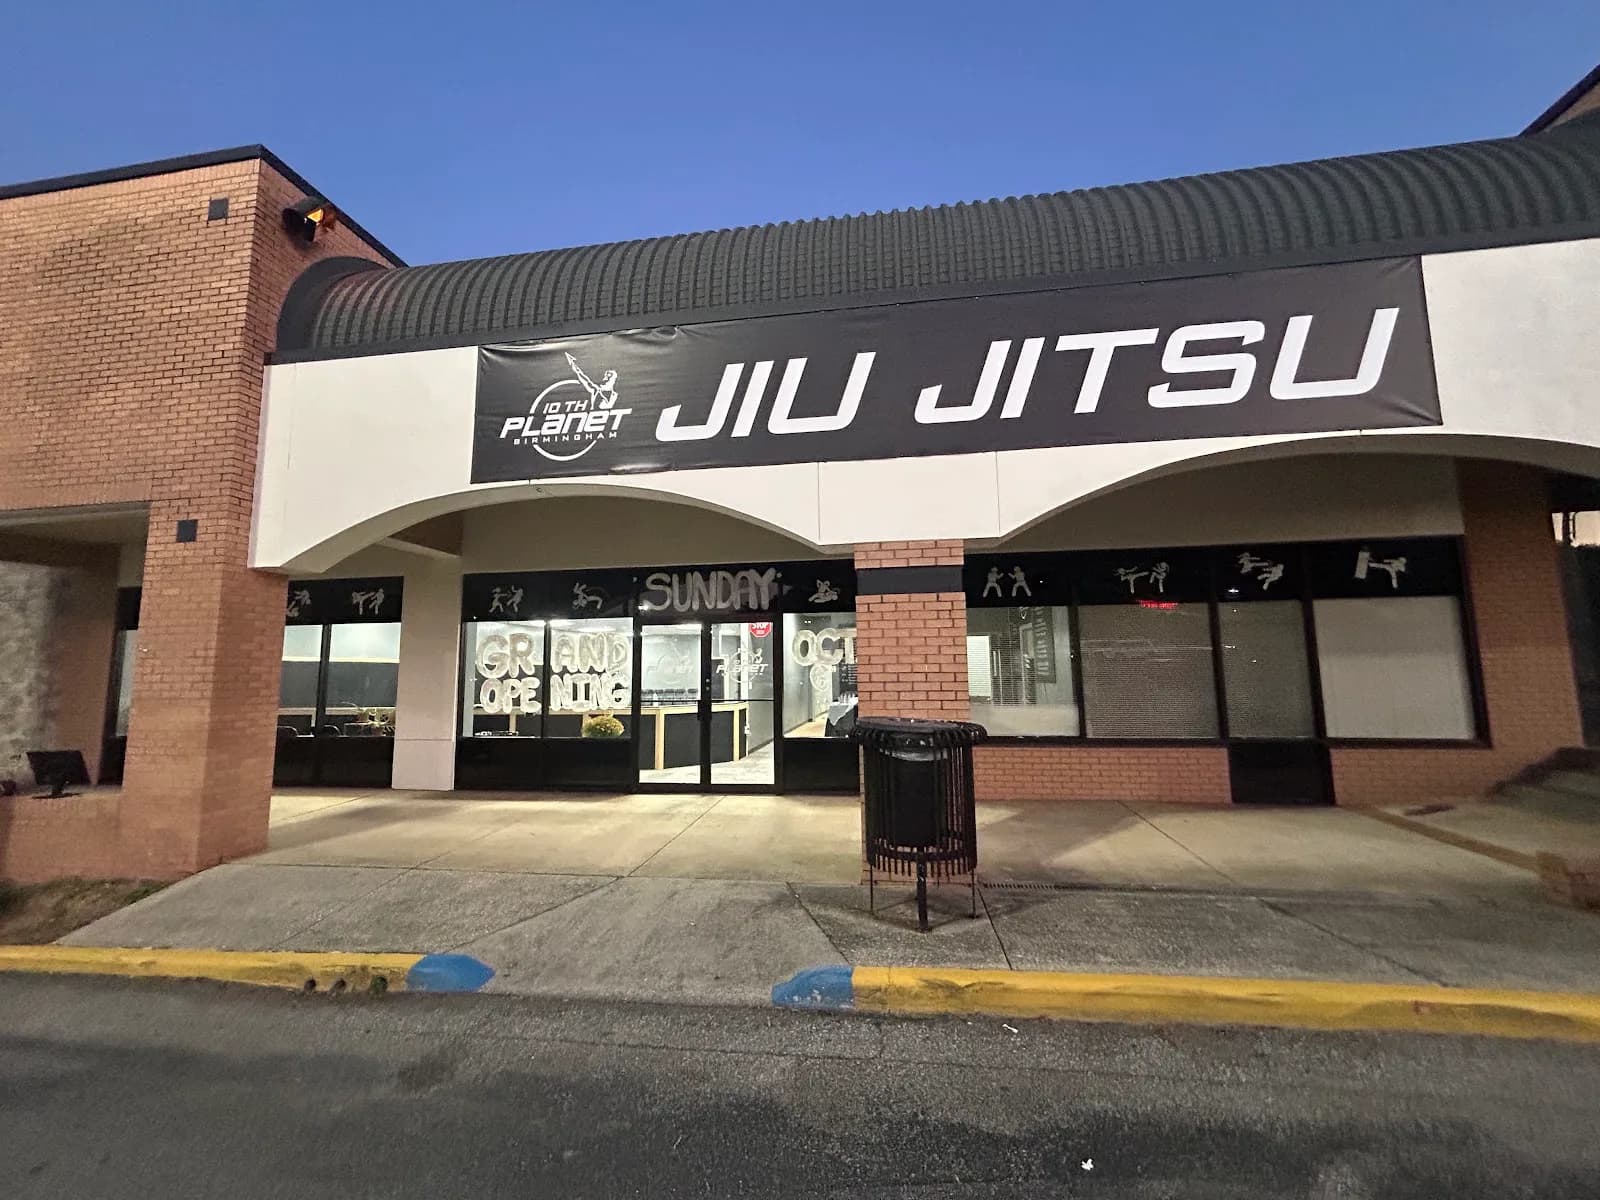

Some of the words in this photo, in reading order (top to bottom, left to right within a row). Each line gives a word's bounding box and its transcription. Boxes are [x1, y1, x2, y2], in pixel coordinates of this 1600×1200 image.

[655, 350, 877, 442] JIU
[913, 307, 1400, 426] JITSU
[513, 432, 617, 445] BIRMINGHAM
[644, 568, 776, 610] SUNDAY
